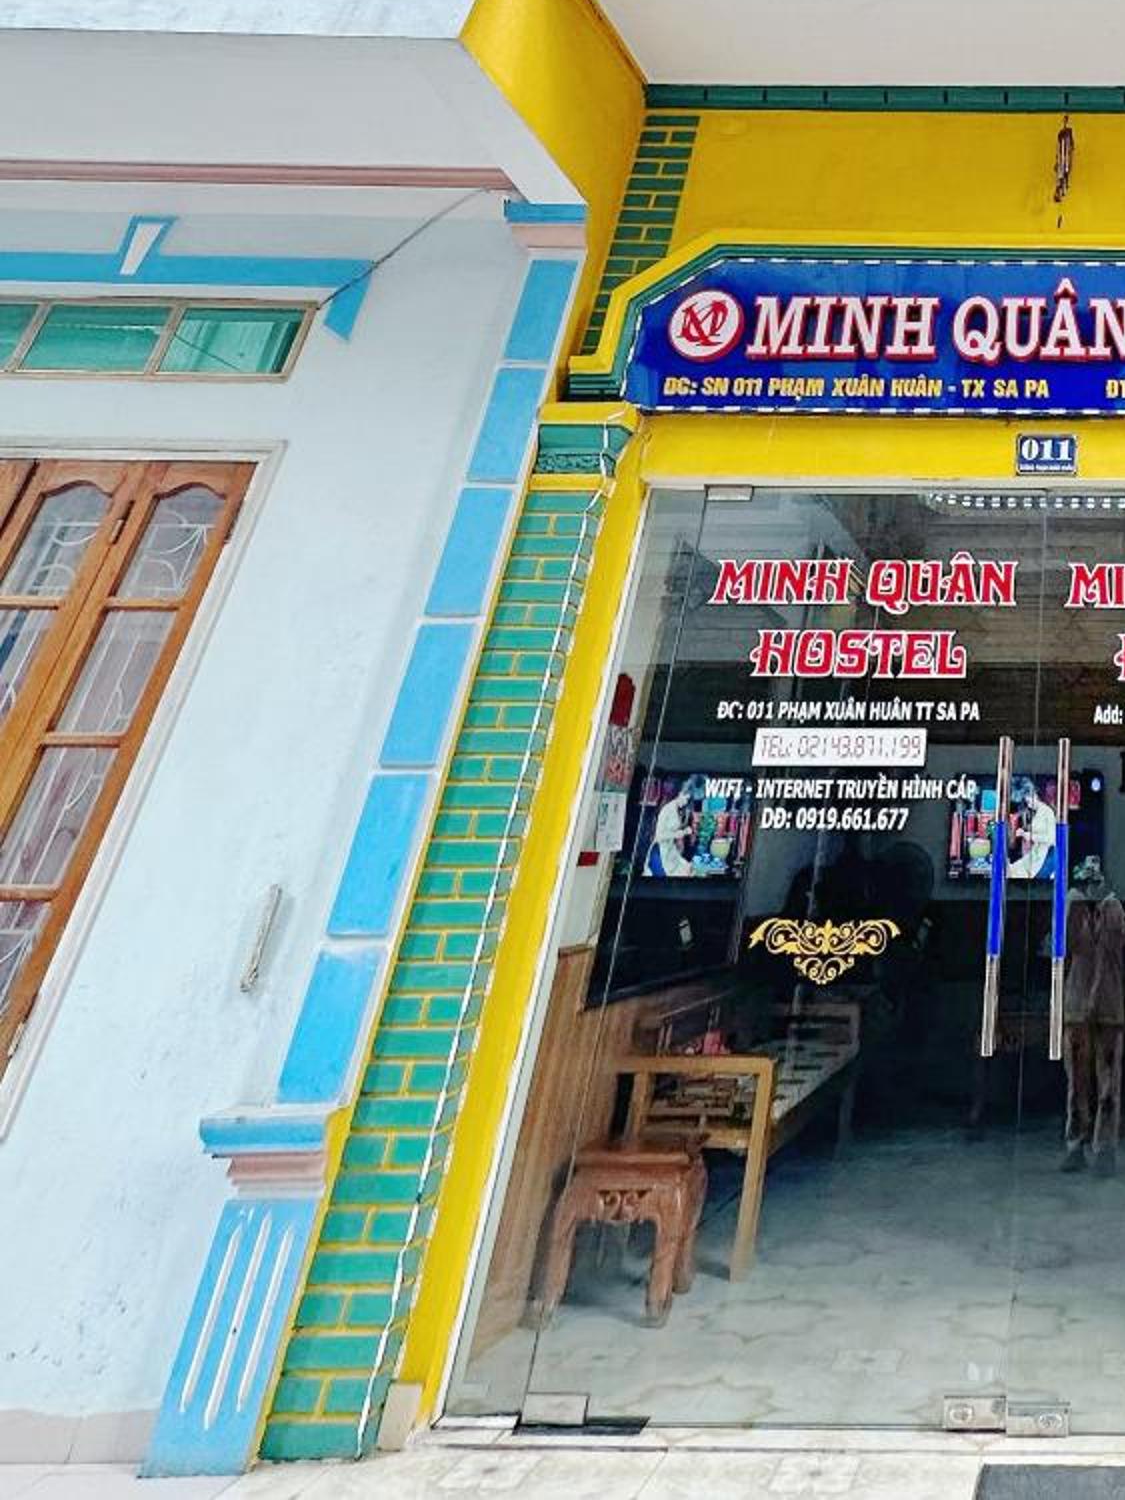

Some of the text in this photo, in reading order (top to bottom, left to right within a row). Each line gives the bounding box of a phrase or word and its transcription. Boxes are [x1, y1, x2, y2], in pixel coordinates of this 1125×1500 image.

[745, 295, 937, 361] MINH
[701, 376, 730, 396] SN
[733, 376, 763, 396] 011
[768, 376, 825, 401] PHẠM
[831, 373, 885, 397] XUÂN
[890, 373, 943, 397] HUÂN
[961, 379, 985, 398] TX
[993, 379, 1019, 398] SA
[1024, 379, 1050, 398] PA
[1021, 439, 1073, 461] 011
[709, 551, 1019, 614] MINH QUÂN
[749, 629, 968, 679] HOSTEL
[717, 697, 981, 724] ĐC: 011 PHẠM XUÂN HUÂN TT SA PA
[1094, 705, 1123, 725] Add:
[704, 778, 744, 799] WIFI
[755, 779, 835, 799] INTERNET
[837, 772, 898, 799] TRUYỀN
[901, 773, 943, 799] HÌNH
[946, 773, 977, 799] CÁP
[761, 807, 909, 830] DĐ: 0919.661.677
